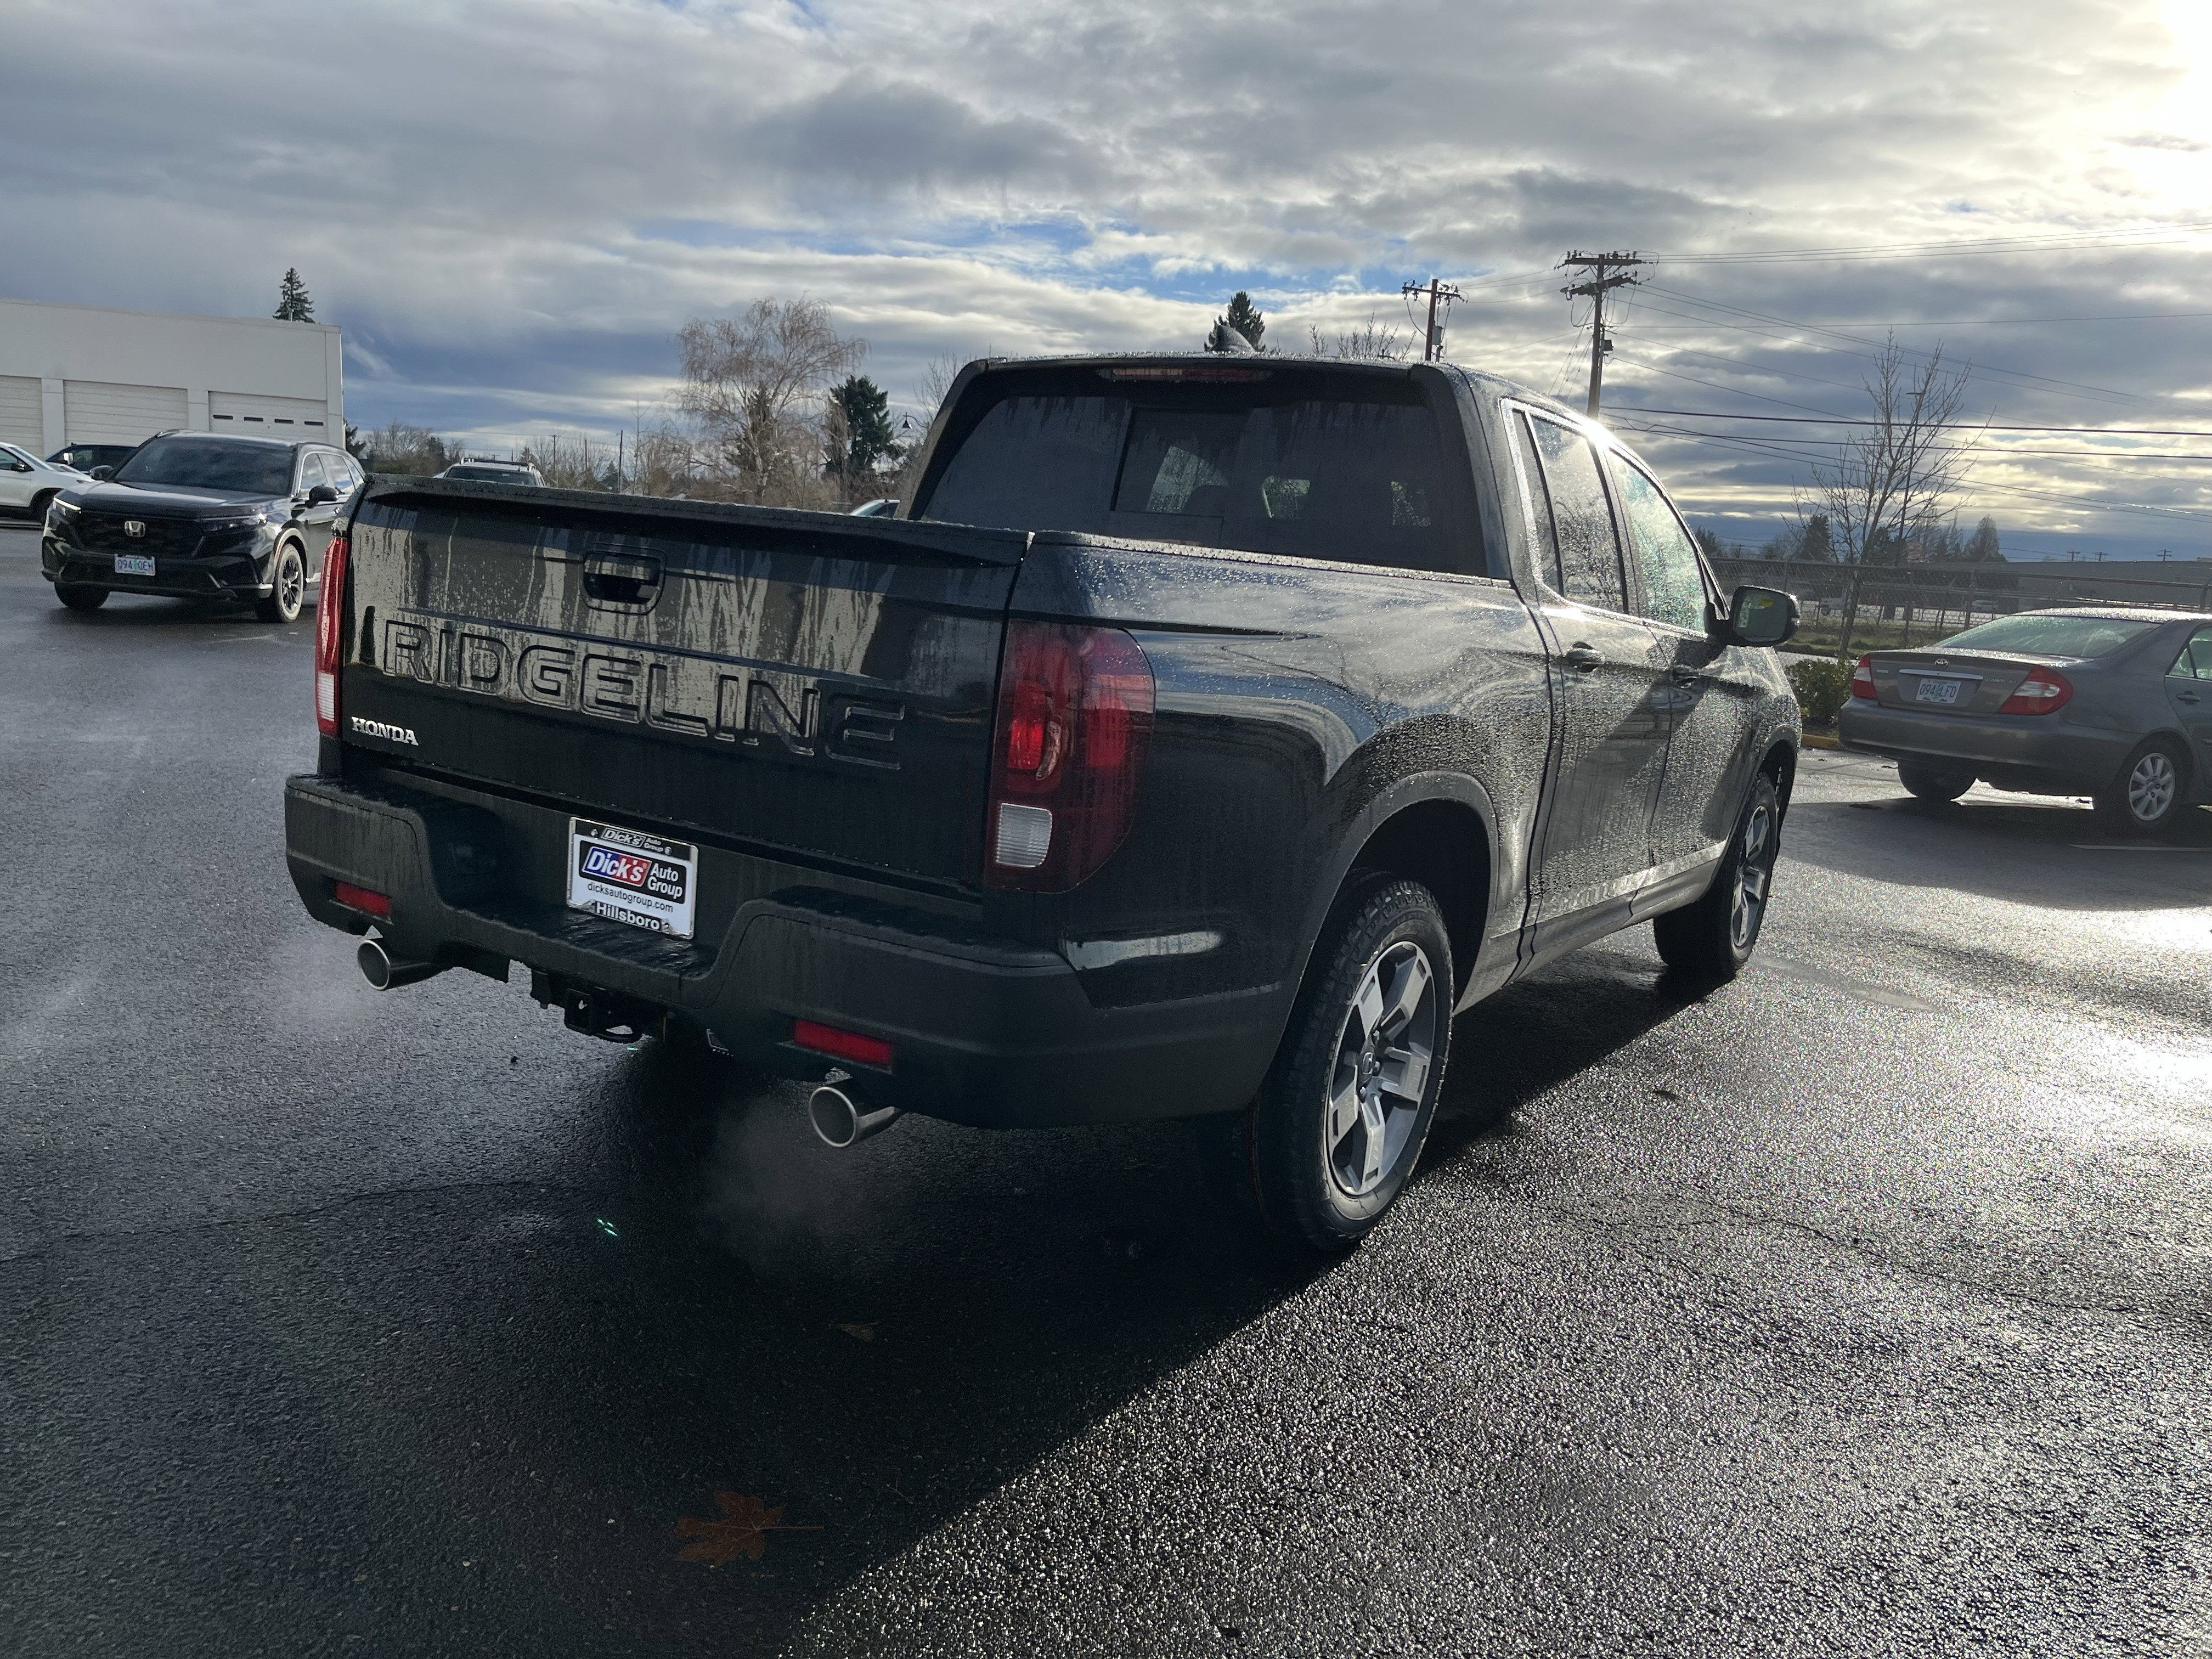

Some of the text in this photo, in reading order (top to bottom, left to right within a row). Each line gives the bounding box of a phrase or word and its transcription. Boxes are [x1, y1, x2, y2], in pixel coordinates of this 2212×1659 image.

[386, 619, 906, 770] RIDGELINE
[1920, 684, 1957, 698] 094 LFD
[351, 716, 419, 746] HONDA
[603, 830, 641, 845] Dick's
[586, 850, 644, 882] Dick's
[650, 862, 679, 882] Auto
[587, 882, 674, 913] dicksautogroup.com
[647, 876, 683, 899] Group
[596, 901, 661, 930] Hillsboro
